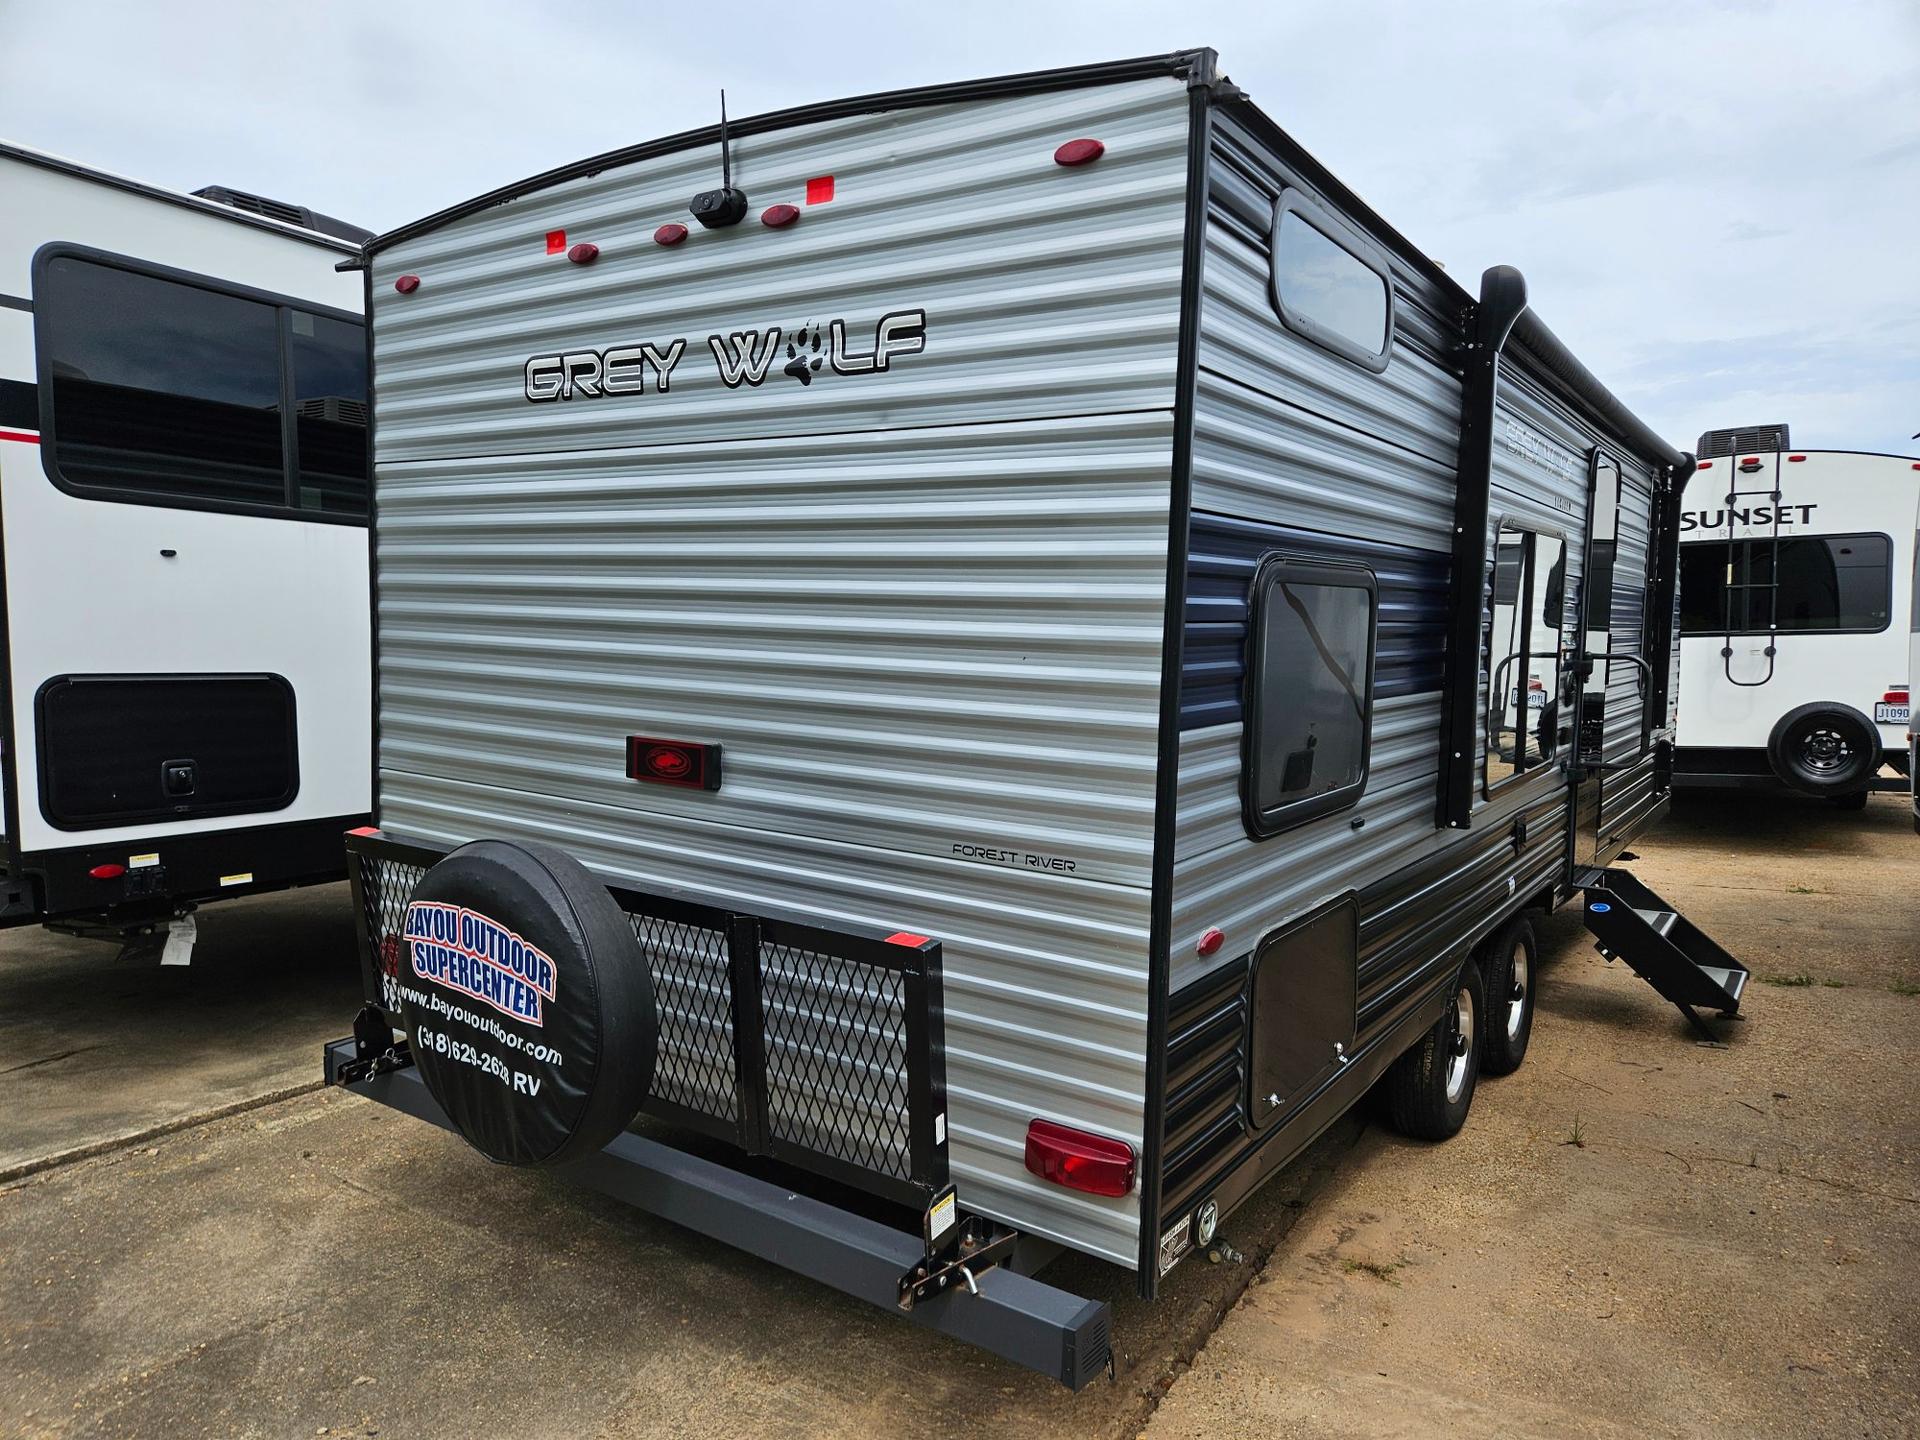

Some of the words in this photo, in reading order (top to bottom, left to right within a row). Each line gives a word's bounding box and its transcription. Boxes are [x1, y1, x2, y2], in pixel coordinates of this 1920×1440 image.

[524, 338, 687, 402] GREY
[1680, 504, 1818, 531] SUNSET
[1696, 525, 1797, 540] TRAIL
[952, 844, 1018, 863] FOREST
[1025, 854, 1076, 872] RIVER
[405, 906, 458, 945] BAYOU
[460, 914, 555, 994] OUTDOOR
[415, 942, 539, 1020] SUPERCENTER
[399, 985, 563, 1066] www.bayououtdoor.com
[513, 1071, 542, 1097] RV
